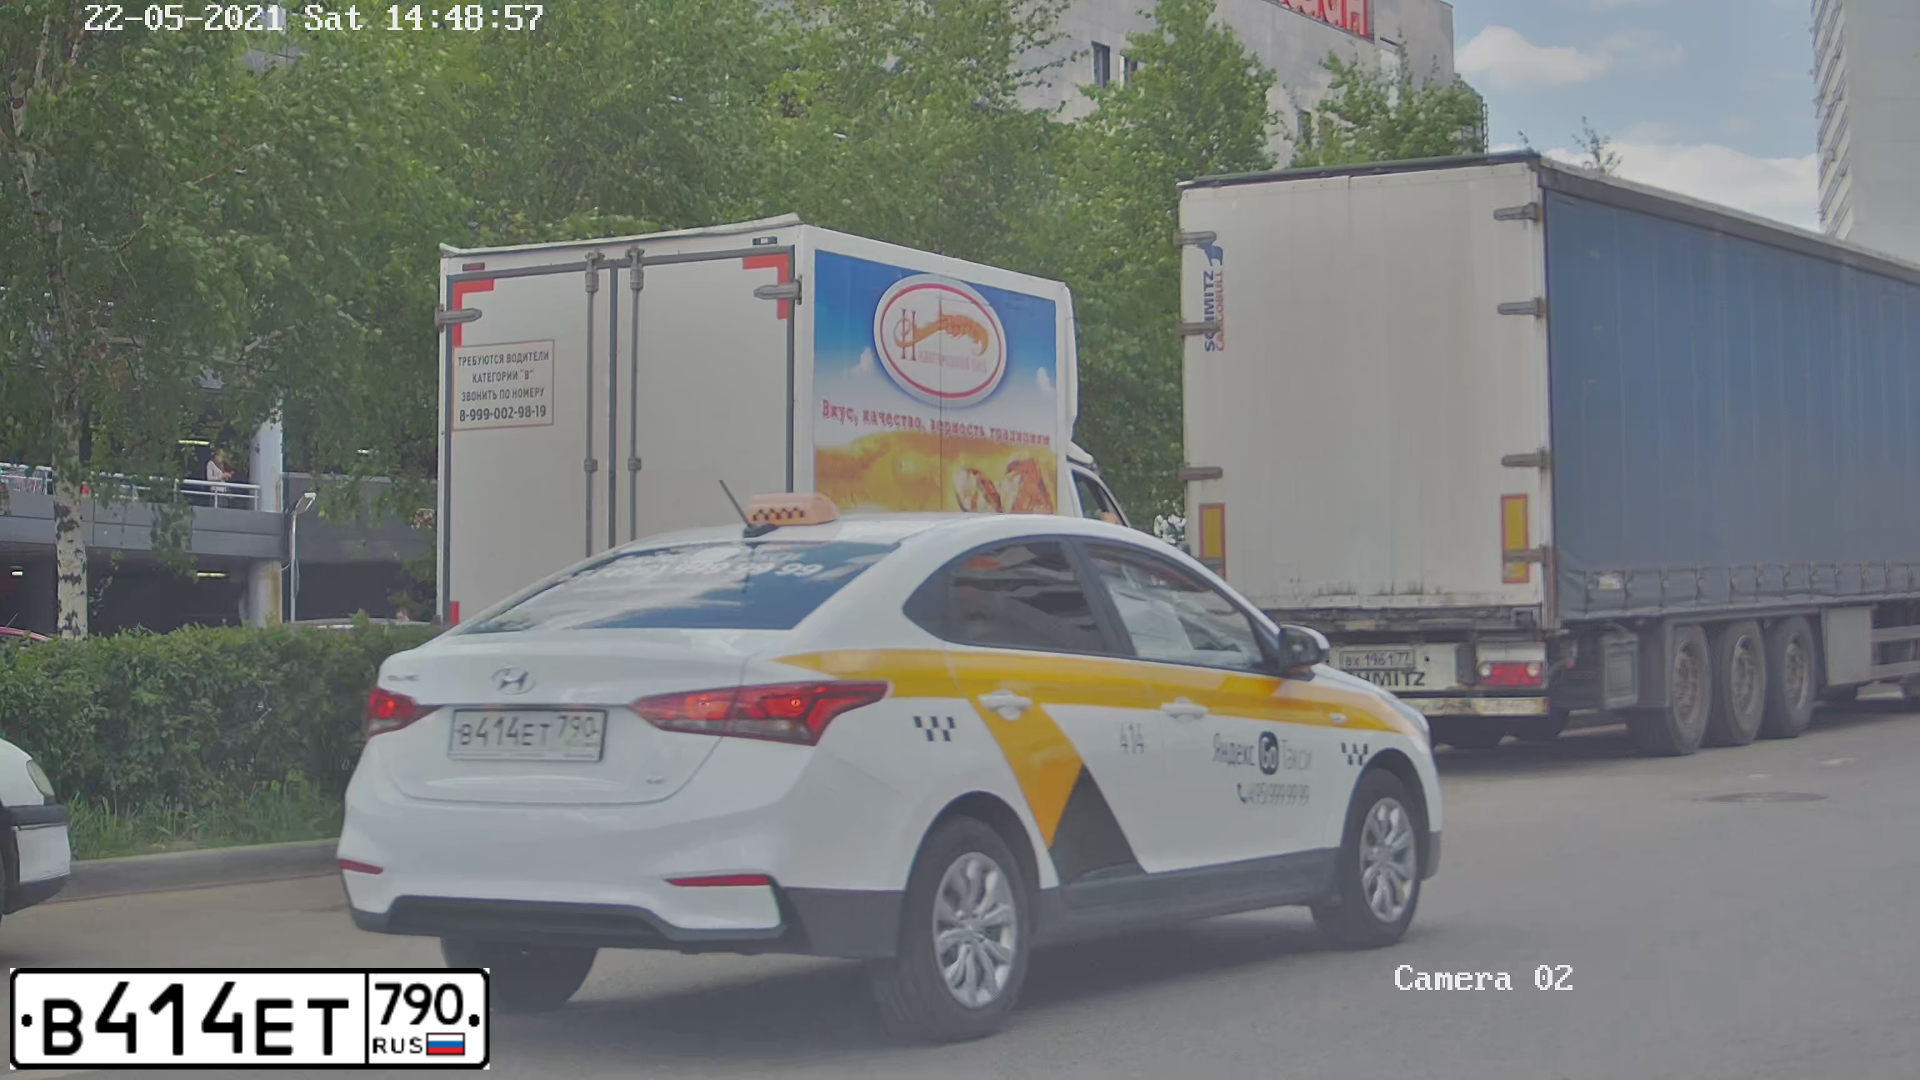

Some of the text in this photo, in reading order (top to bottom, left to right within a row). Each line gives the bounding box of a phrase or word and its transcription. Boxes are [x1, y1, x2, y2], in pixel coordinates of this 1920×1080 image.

[458, 351, 549, 367] ТРЕБУЮТСЯ ВОДИТЕЛИ
[472, 370, 518, 383] КАТЕГОРИИ
[461, 386, 545, 402] ЗВОНИТЬ ПО НОМЕРУ
[459, 405, 547, 422] 8-999-002-98-19
[776, 562, 823, 578] 99
[1350, 670, 1426, 687] HMITZ
[1119, 722, 1145, 755] 414
